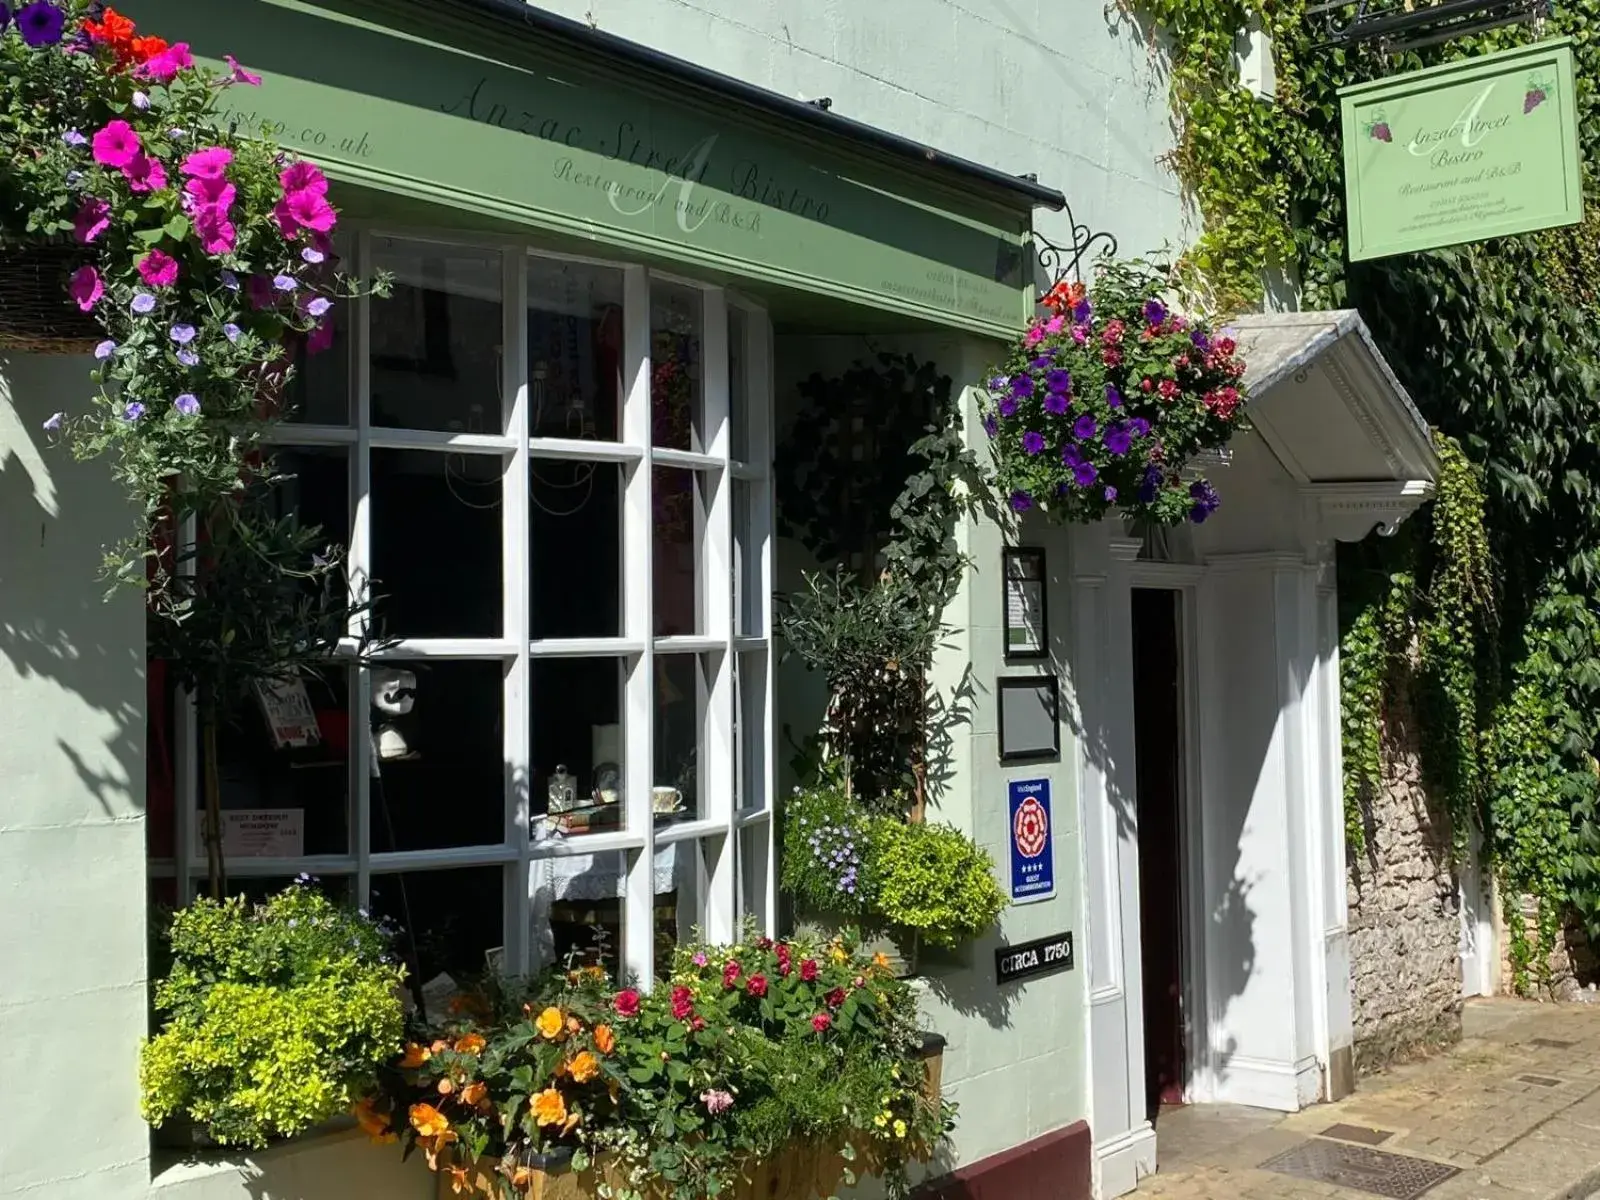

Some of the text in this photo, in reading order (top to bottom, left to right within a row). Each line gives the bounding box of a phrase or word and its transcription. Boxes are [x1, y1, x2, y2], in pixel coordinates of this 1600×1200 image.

[1402, 114, 1510, 148] Anzac Street
[440, 78, 830, 222] Anzac Street Bistro
[1430, 149, 1484, 169] Bistro
[553, 157, 761, 233] Restaurant and B&B
[1001, 941, 1070, 974] CIRCA 1750
